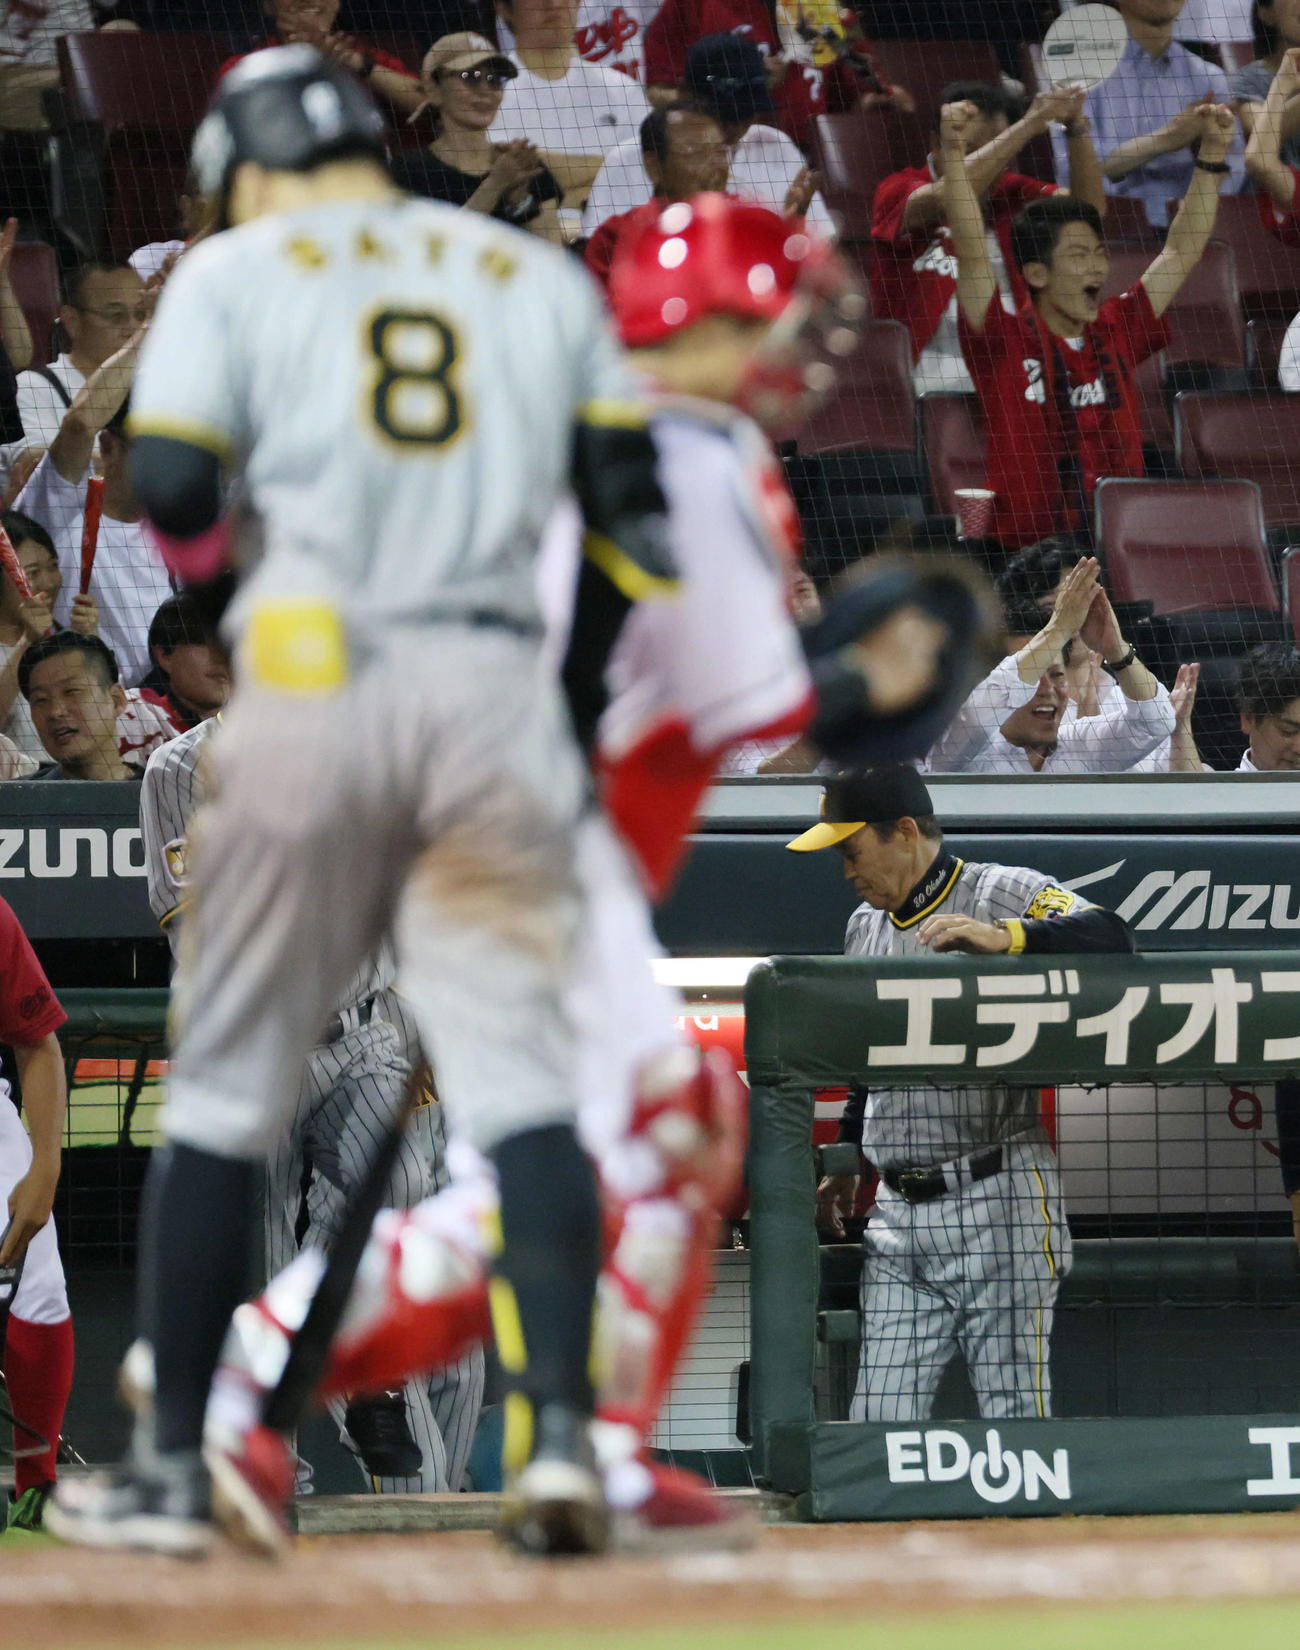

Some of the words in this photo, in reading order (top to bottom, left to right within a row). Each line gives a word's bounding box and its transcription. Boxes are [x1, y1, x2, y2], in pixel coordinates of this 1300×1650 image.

[366, 302, 465, 454] 8
[1114, 870, 1300, 930] MIZU
[885, 1428, 1071, 1502] EDION
